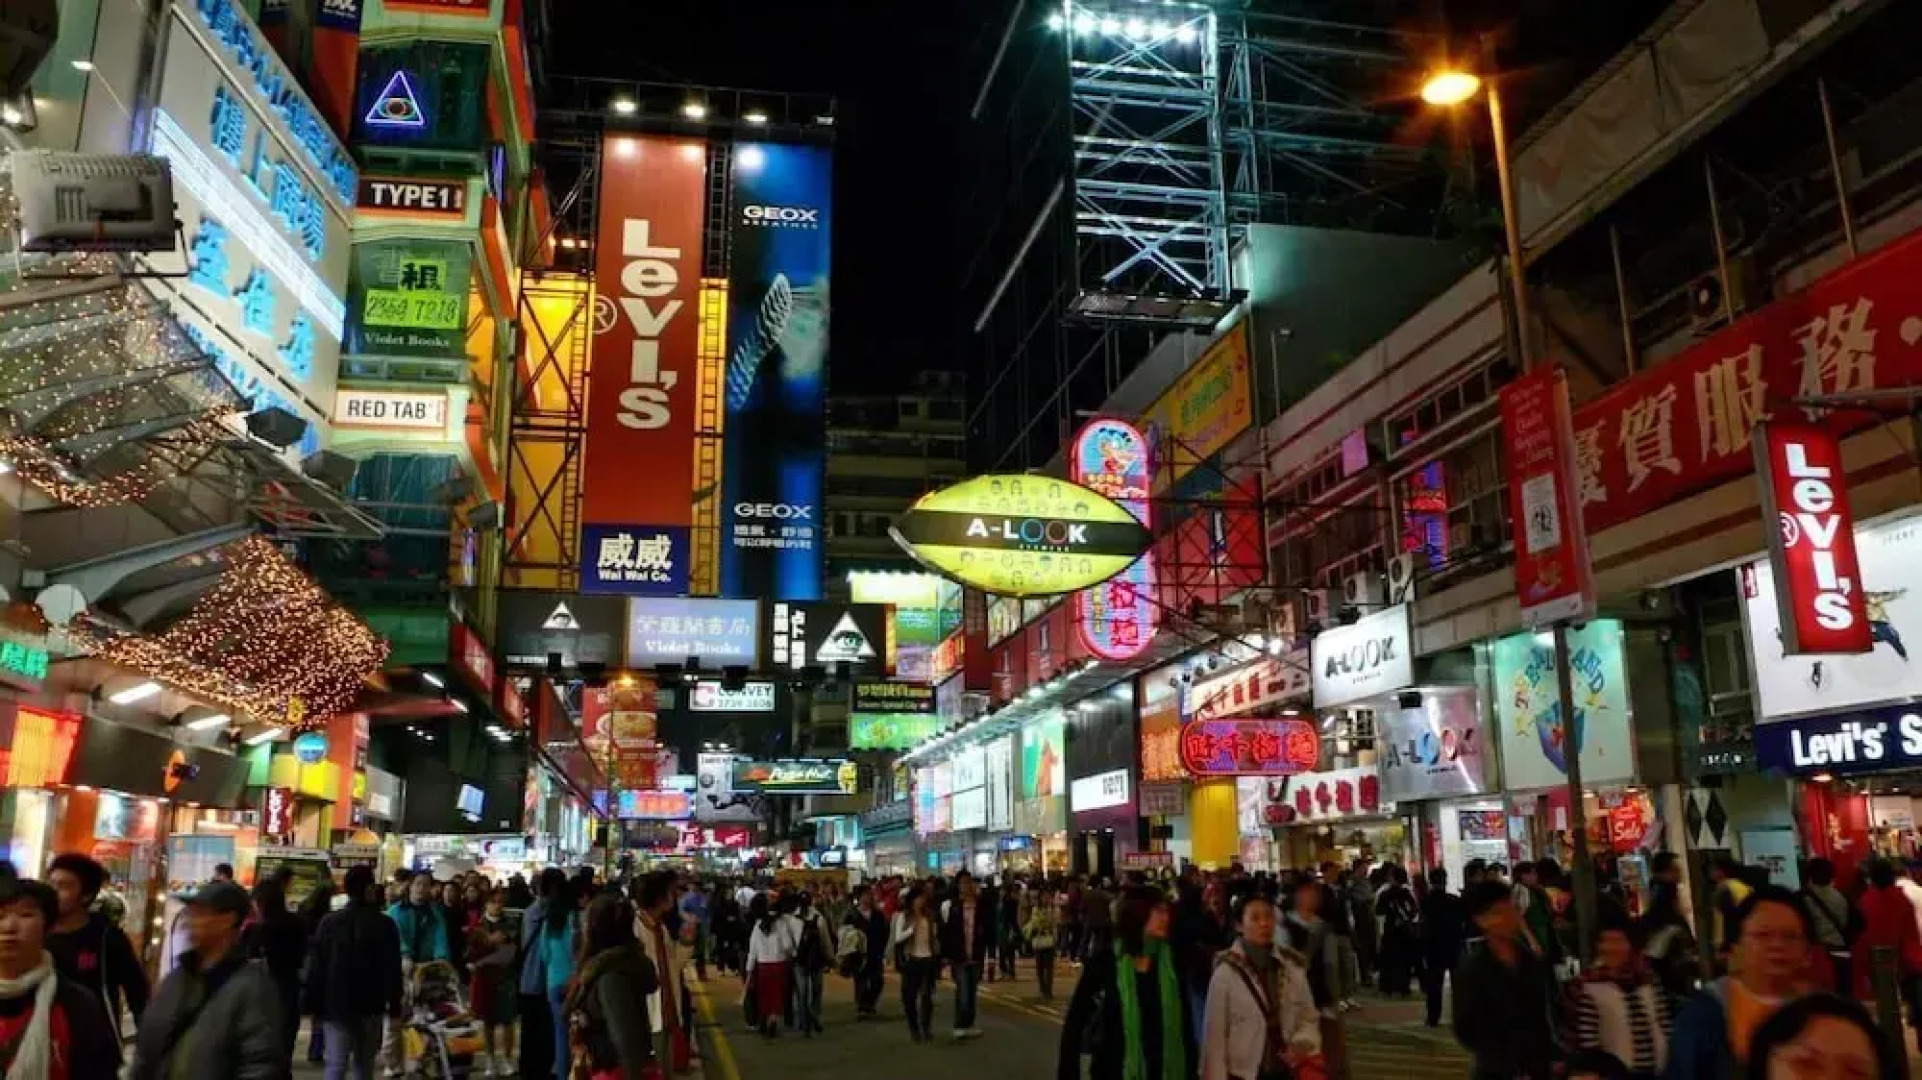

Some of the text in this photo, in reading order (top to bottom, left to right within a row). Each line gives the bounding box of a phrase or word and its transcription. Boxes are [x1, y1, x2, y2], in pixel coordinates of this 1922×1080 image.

[370, 182, 449, 209] TYPE1
[743, 204, 818, 222] GEOX
[347, 398, 427, 420] RED TAB
[734, 502, 812, 519] GEOX
[966, 518, 1087, 545] A-LOOK
[597, 532, 673, 570] 威威
[644, 640, 690, 653] Violet
[1324, 635, 1397, 680] A-LOOK
[1790, 722, 1887, 767] Levi's
